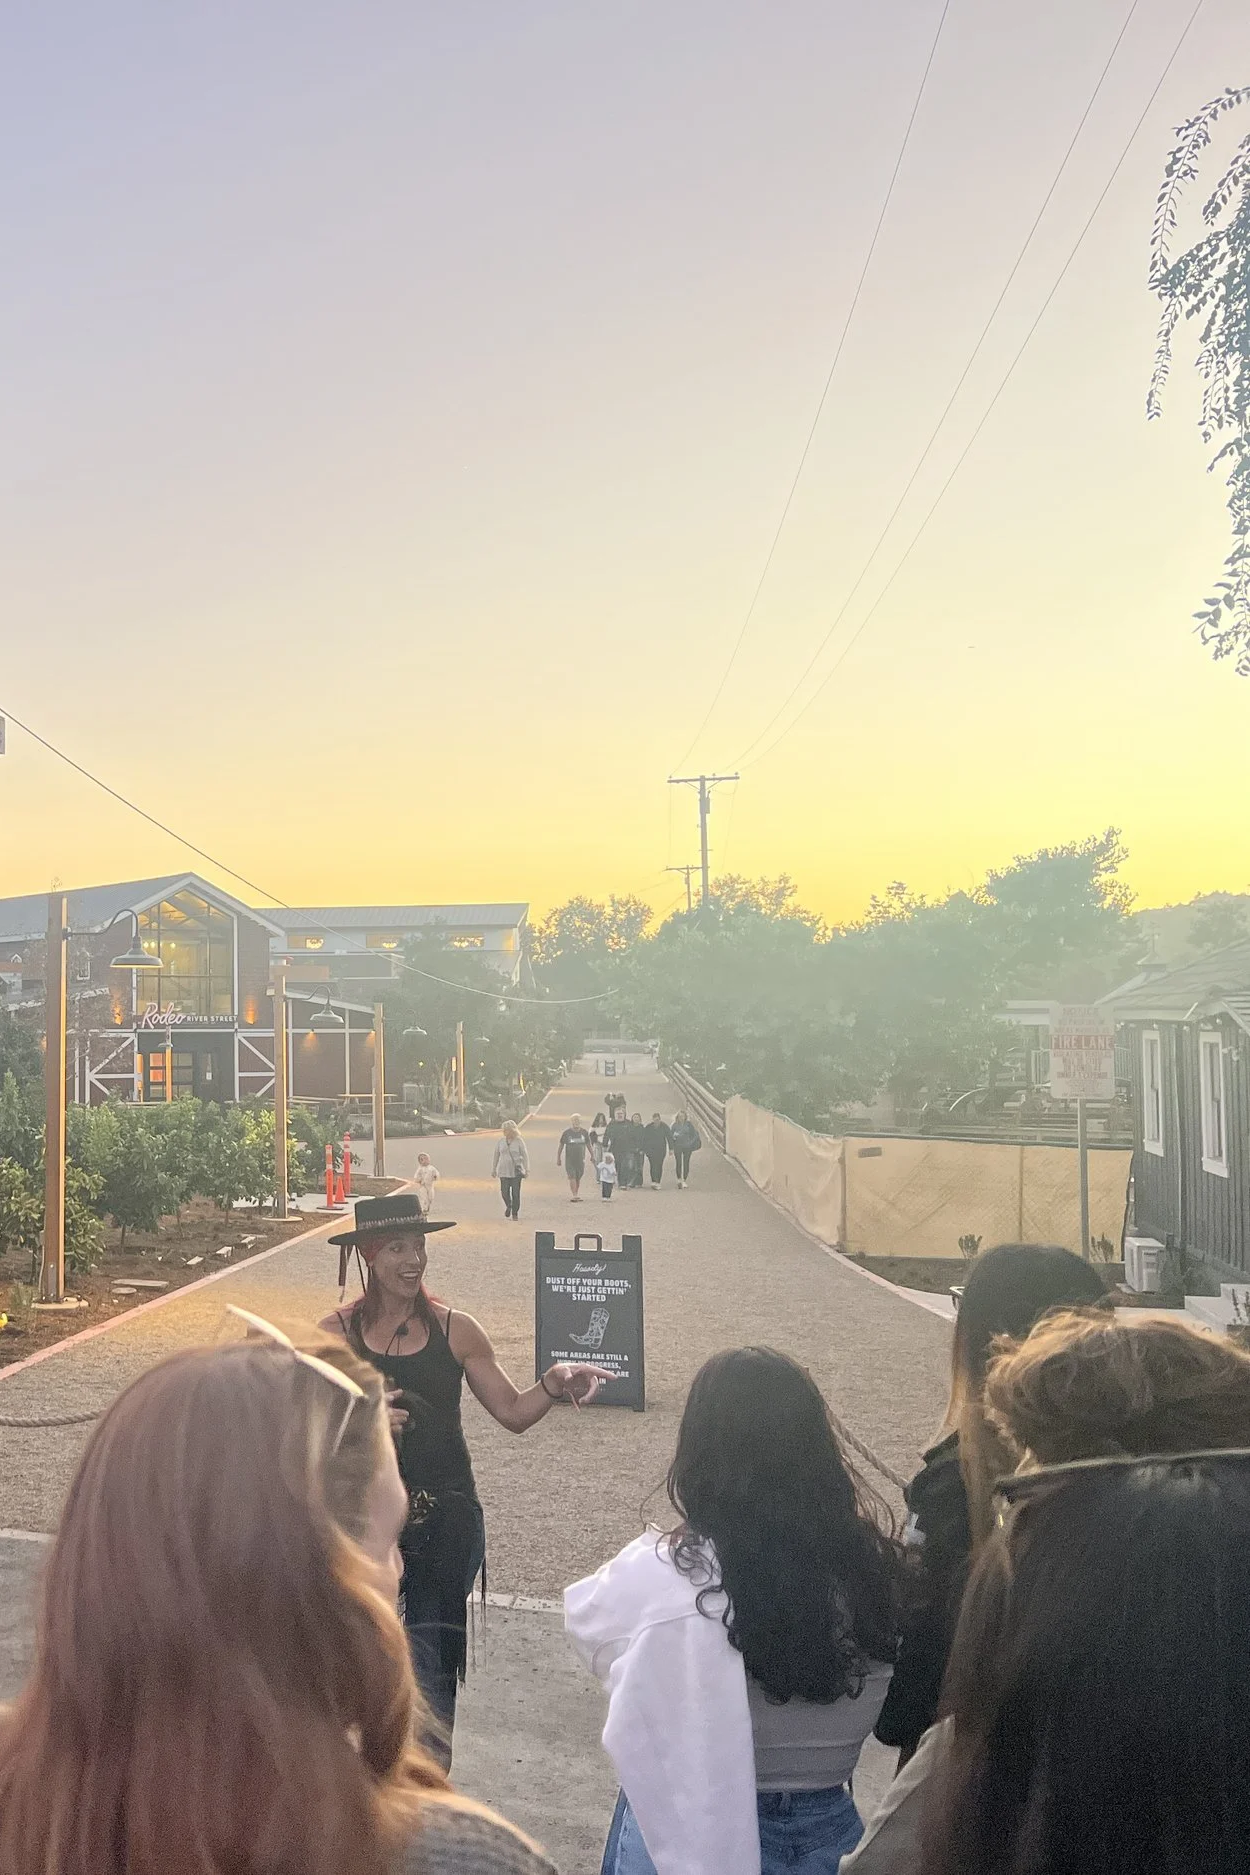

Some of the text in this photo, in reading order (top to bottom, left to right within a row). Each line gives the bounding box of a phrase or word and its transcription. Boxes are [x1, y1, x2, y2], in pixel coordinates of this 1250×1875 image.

[141, 1002, 187, 1029] Rodeo
[210, 1014, 238, 1023] STREET
[1051, 1035, 1113, 1050] FIRE LANE
[572, 1263, 607, 1276] Howdy!
[546, 1276, 632, 1288] DUST OFF YOUR BOOTS,
[551, 1284, 627, 1295] WE'RE JUST GETTIN'
[572, 1293, 607, 1302] STARTED
[550, 1350, 569, 1358] SOME
[605, 1353, 623, 1361] STILL
[623, 1354, 629, 1362] A
